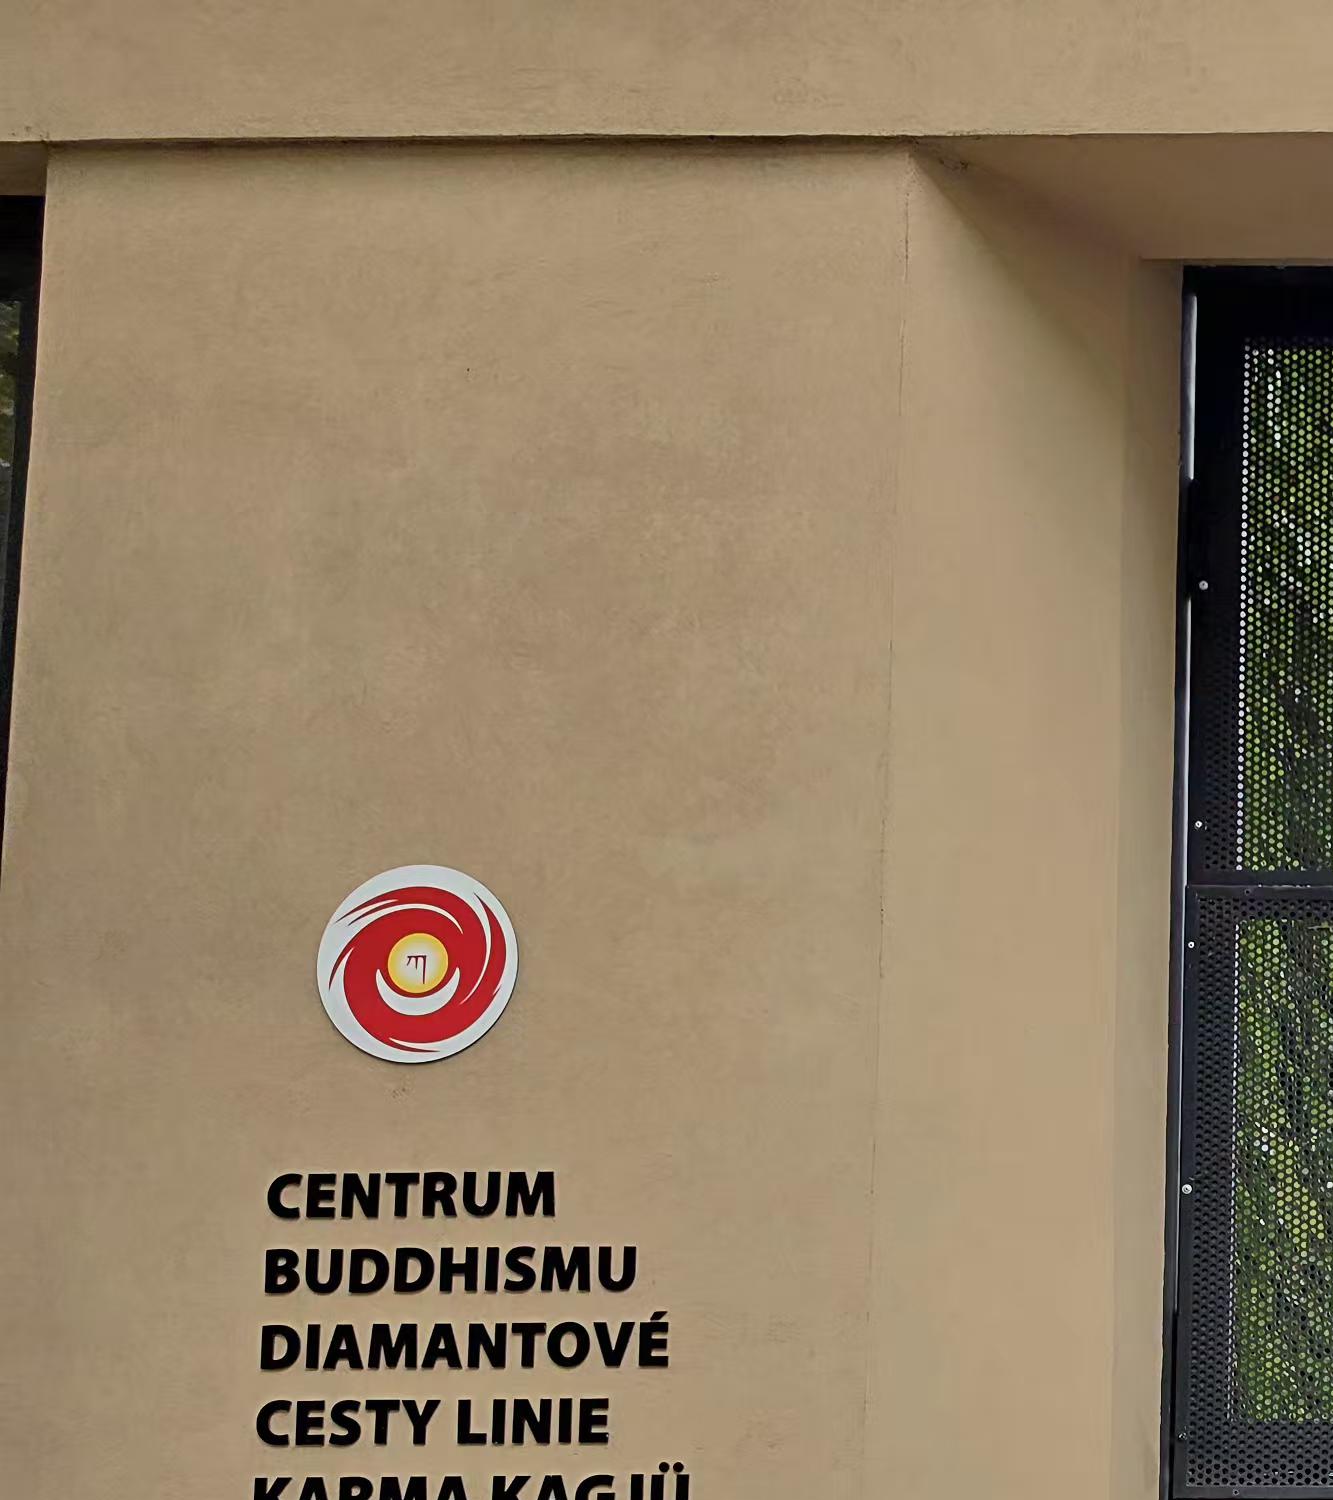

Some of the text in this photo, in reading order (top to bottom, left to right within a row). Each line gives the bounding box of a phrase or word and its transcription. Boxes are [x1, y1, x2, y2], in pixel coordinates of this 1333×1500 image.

[266, 1171, 556, 1220] CENTRUM
[264, 1246, 638, 1295] BUDDHISMU
[260, 1310, 670, 1371] DIAMANTOVÉ
[256, 1397, 610, 1447] CESTY LINIE
